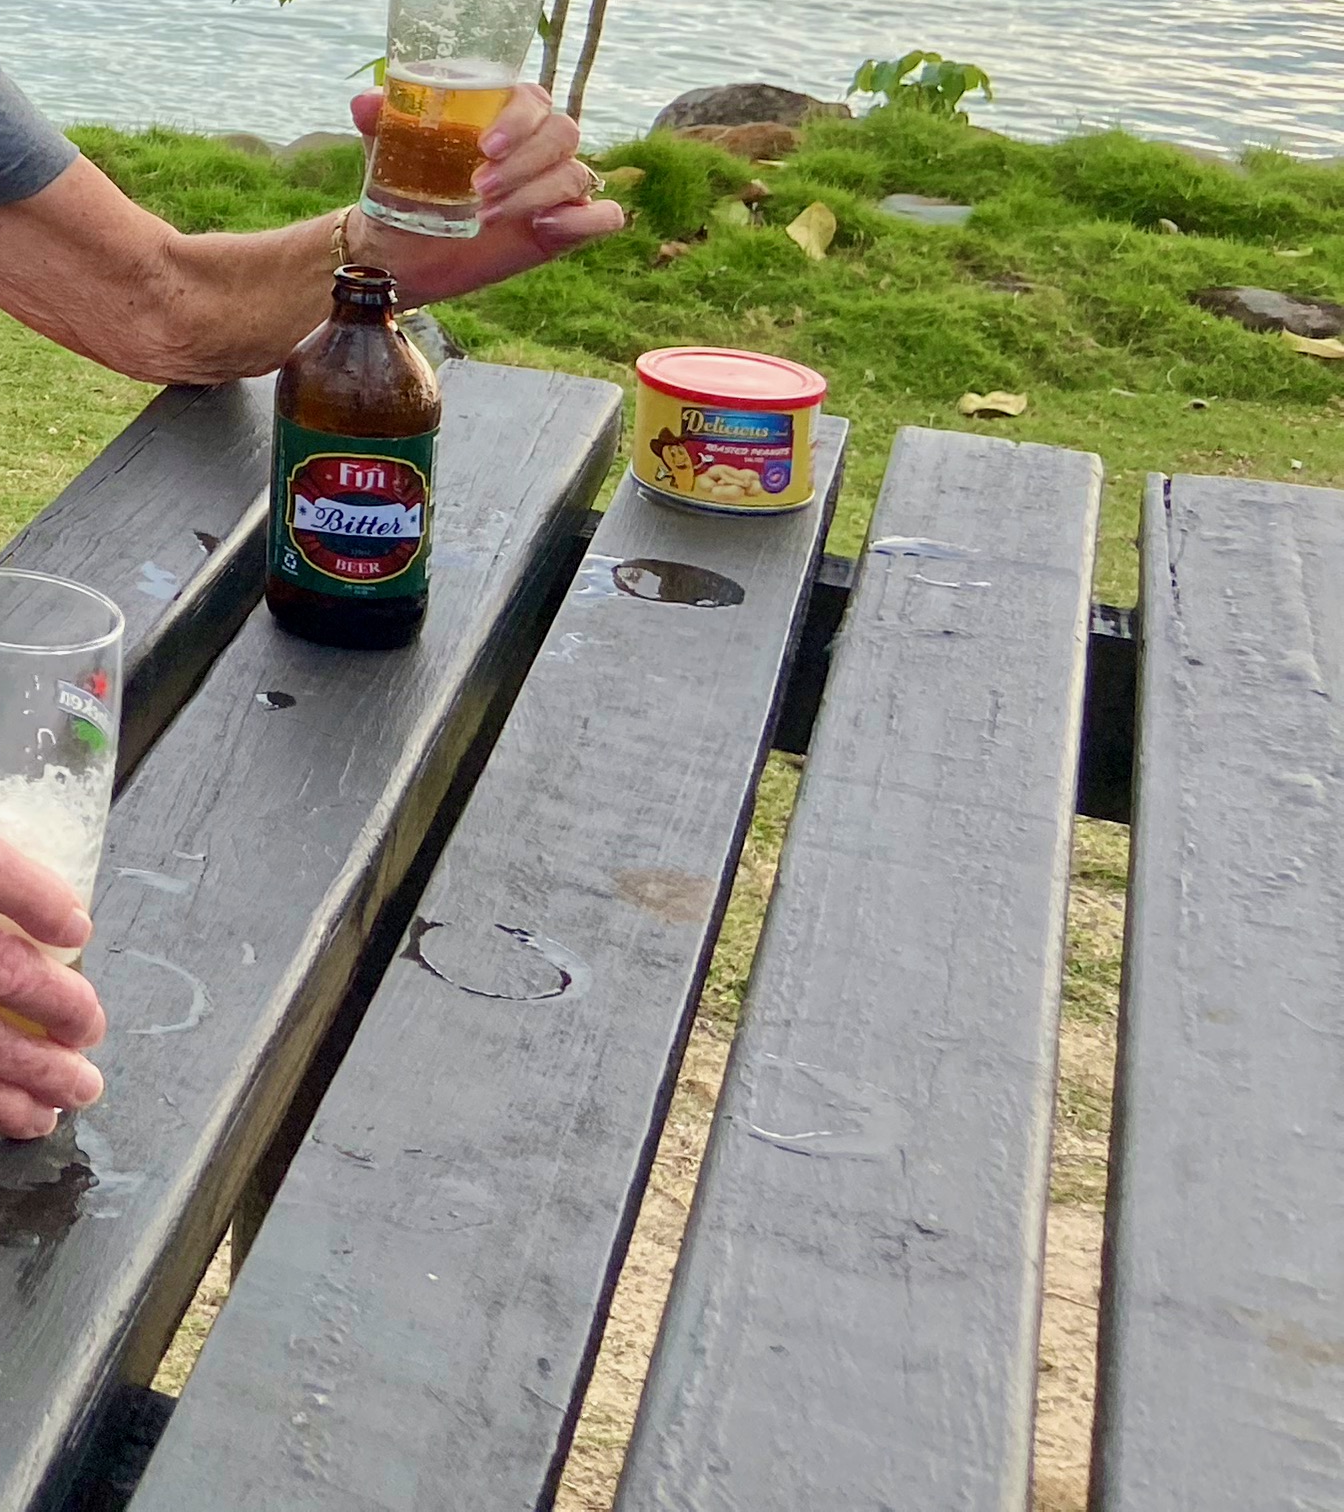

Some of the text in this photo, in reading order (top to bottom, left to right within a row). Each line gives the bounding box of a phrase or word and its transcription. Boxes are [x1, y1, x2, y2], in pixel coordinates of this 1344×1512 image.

[682, 409, 769, 438] Delicious
[310, 505, 403, 536] Bitter
[335, 558, 382, 574] BEER
